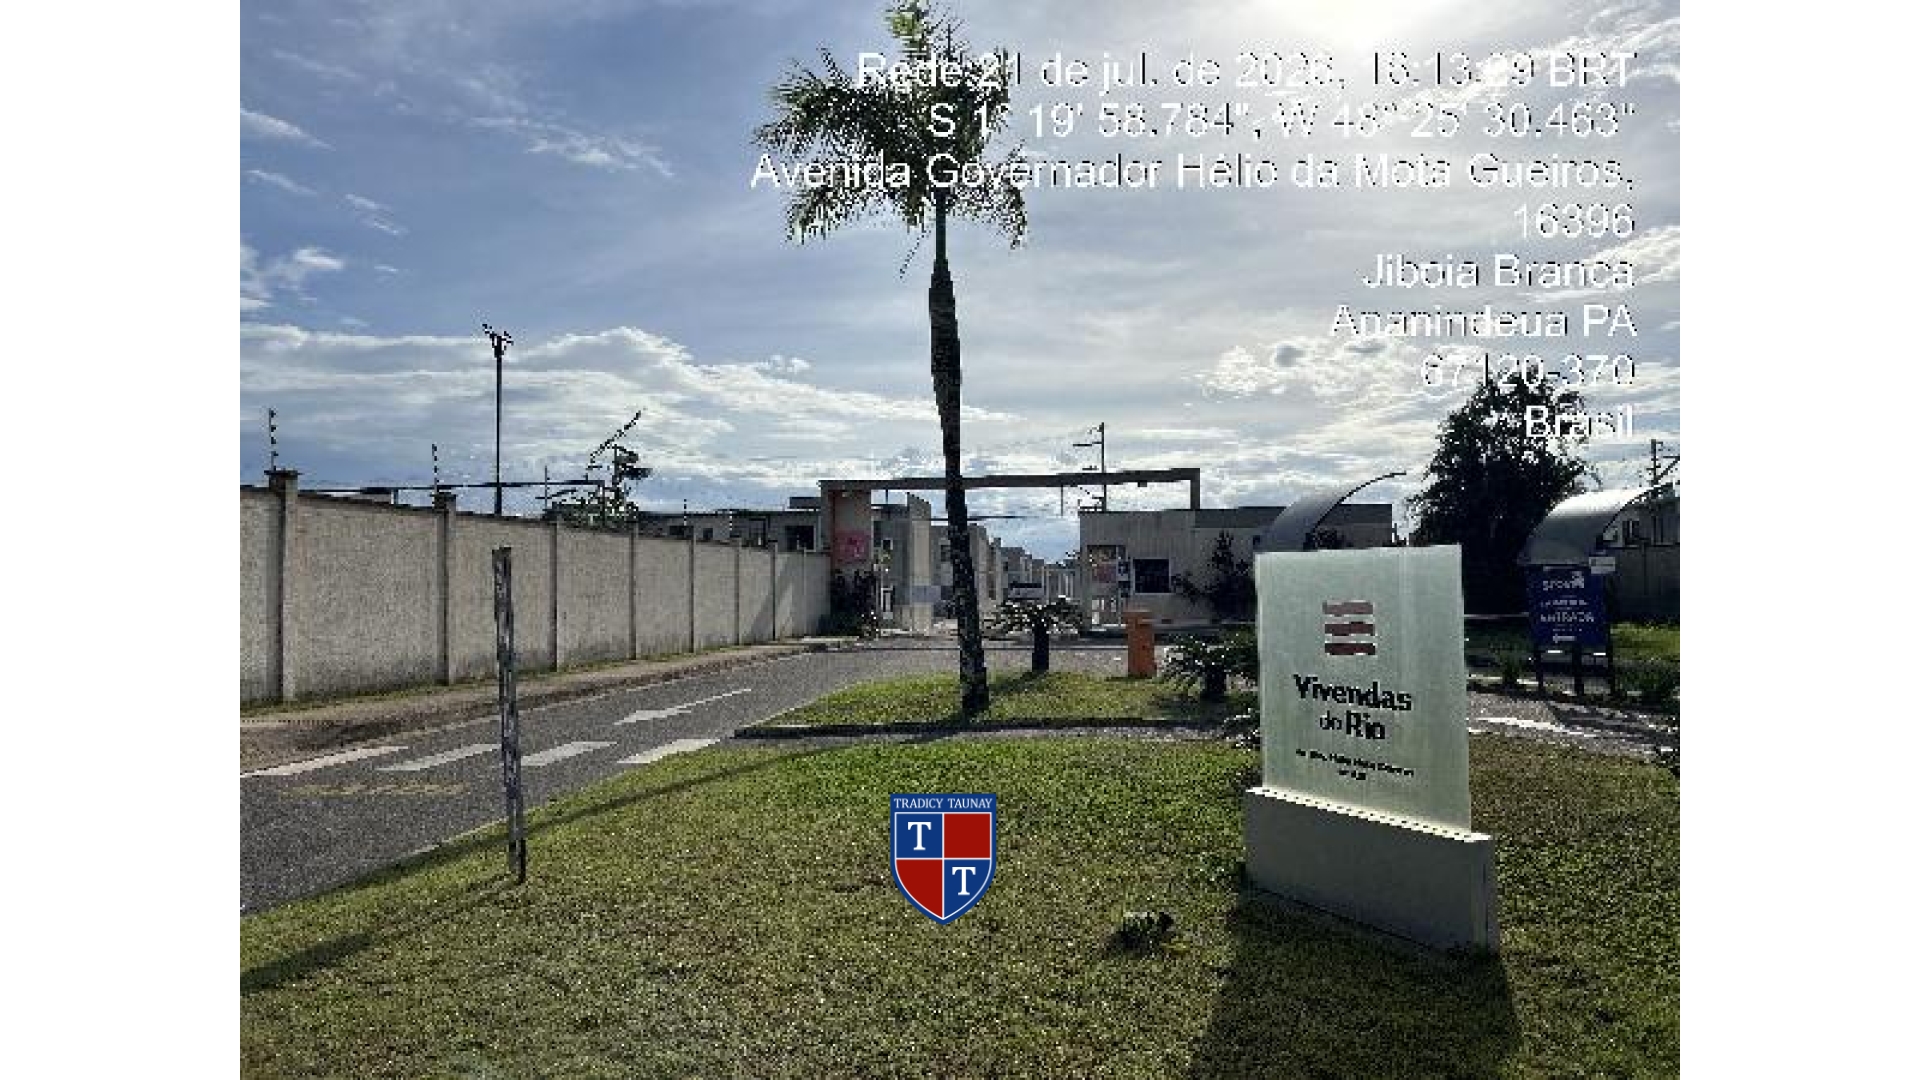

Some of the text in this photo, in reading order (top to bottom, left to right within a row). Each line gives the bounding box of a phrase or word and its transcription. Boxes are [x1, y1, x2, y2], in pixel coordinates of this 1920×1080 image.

[1293, 673, 1412, 711] Vivendas
[1319, 710, 1386, 740] do Rio
